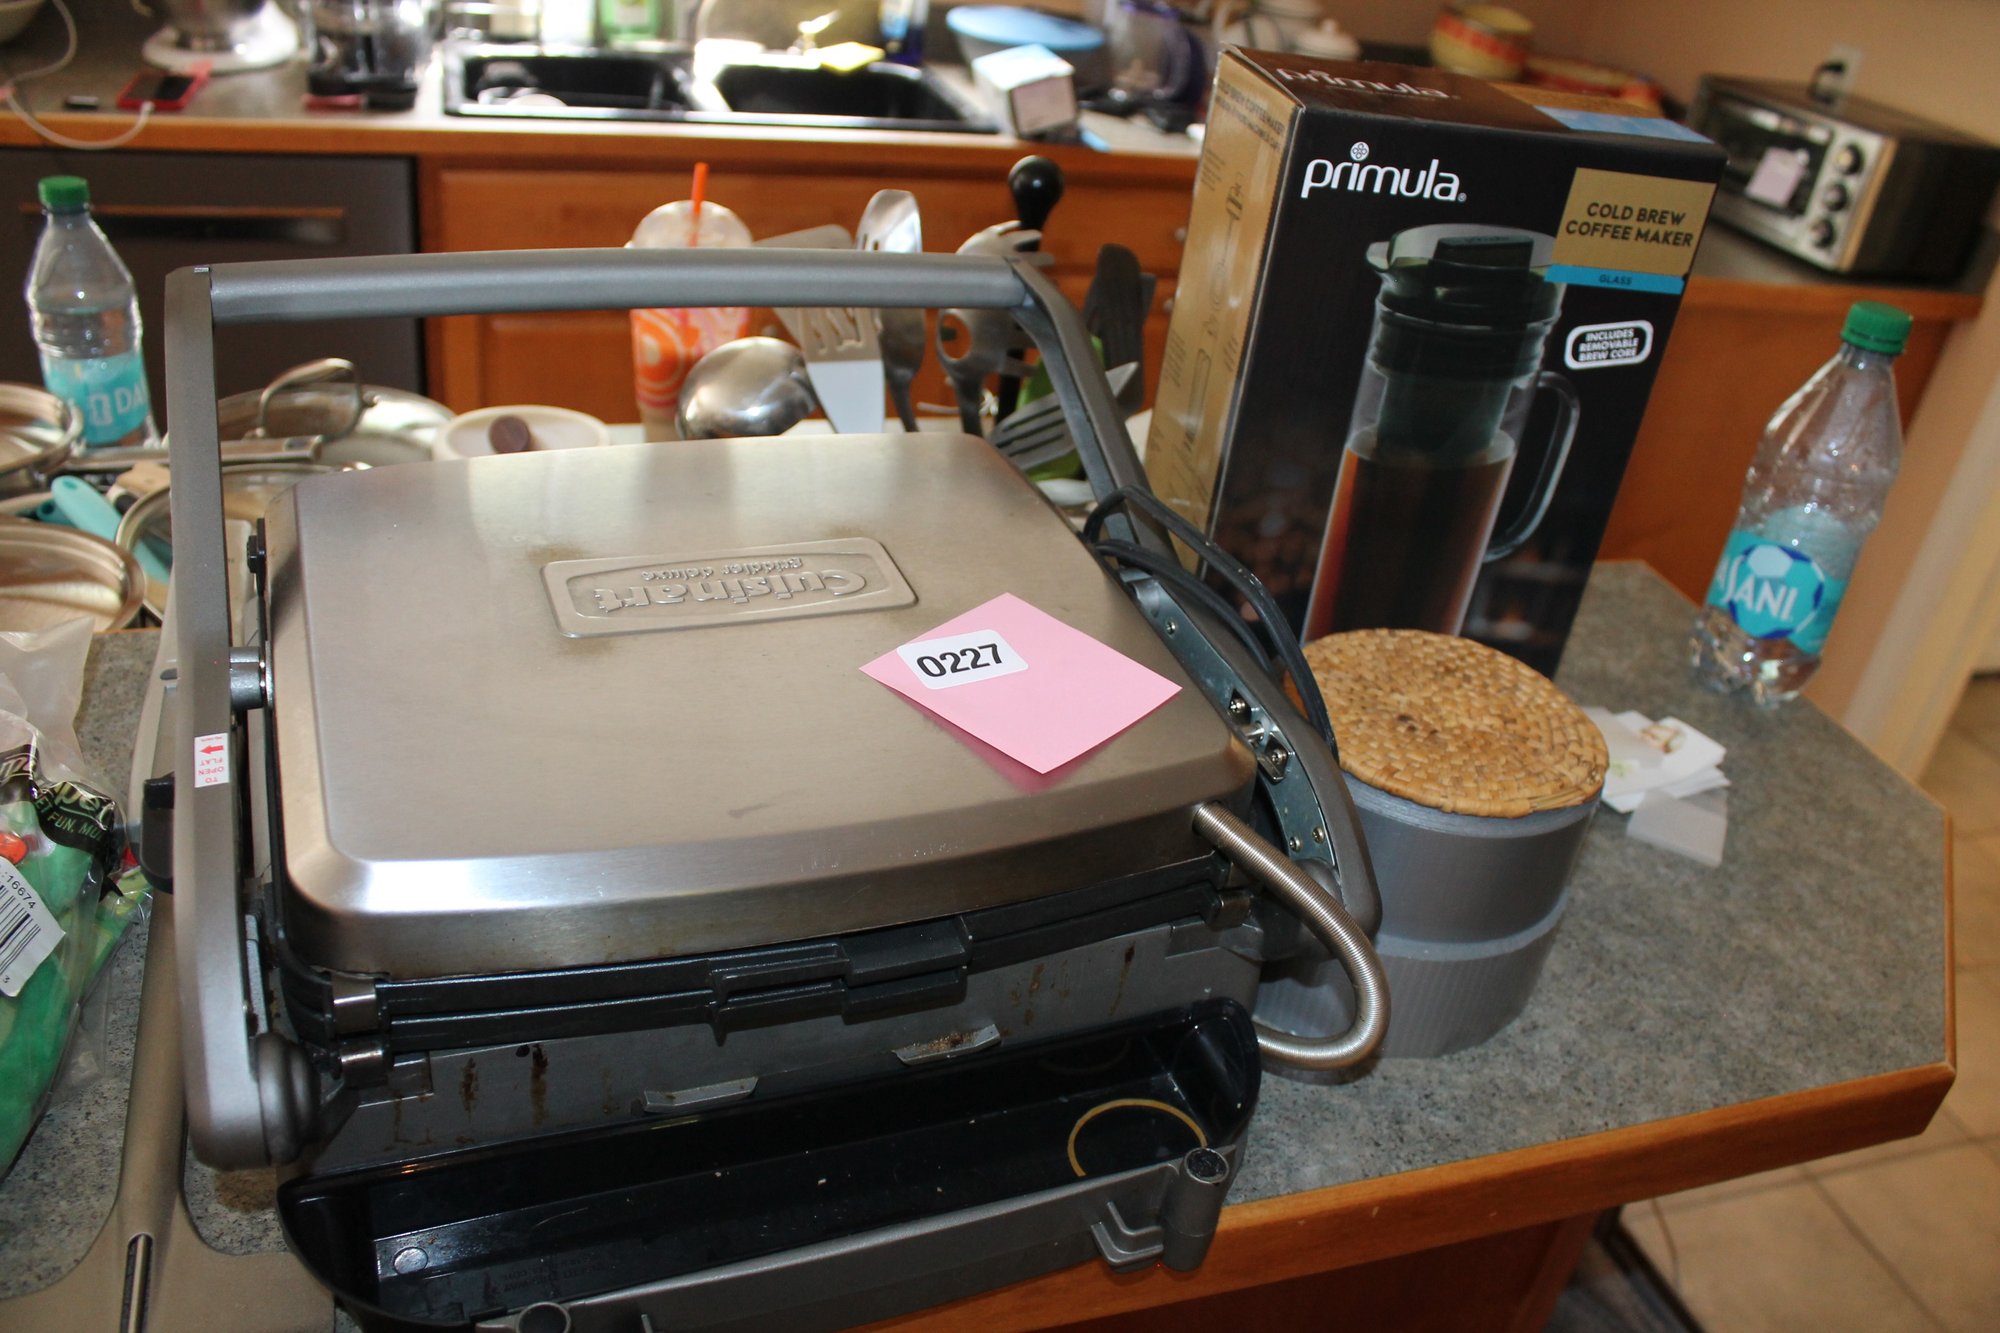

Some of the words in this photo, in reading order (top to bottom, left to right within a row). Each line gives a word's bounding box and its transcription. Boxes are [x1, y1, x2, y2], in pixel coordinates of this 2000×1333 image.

[1301, 141, 1460, 201] primula
[1587, 202, 1634, 220] COLD
[1636, 207, 1686, 226] BREW
[1566, 220, 1633, 240] COFFEE
[1635, 228, 1693, 247] MAKER
[1599, 273, 1633, 286] GLASS
[1586, 328, 1635, 342] INCLUDES
[1578, 337, 1640, 353] REMOVABLE
[1578, 350, 1609, 362] BREW
[640, 565, 714, 582] deluxe
[720, 556, 803, 575] griddler
[595, 569, 866, 613] Cuisinart
[916, 643, 1002, 678] 0227
[200, 757, 223, 766] FLAT
[198, 766, 224, 775] OPEN
